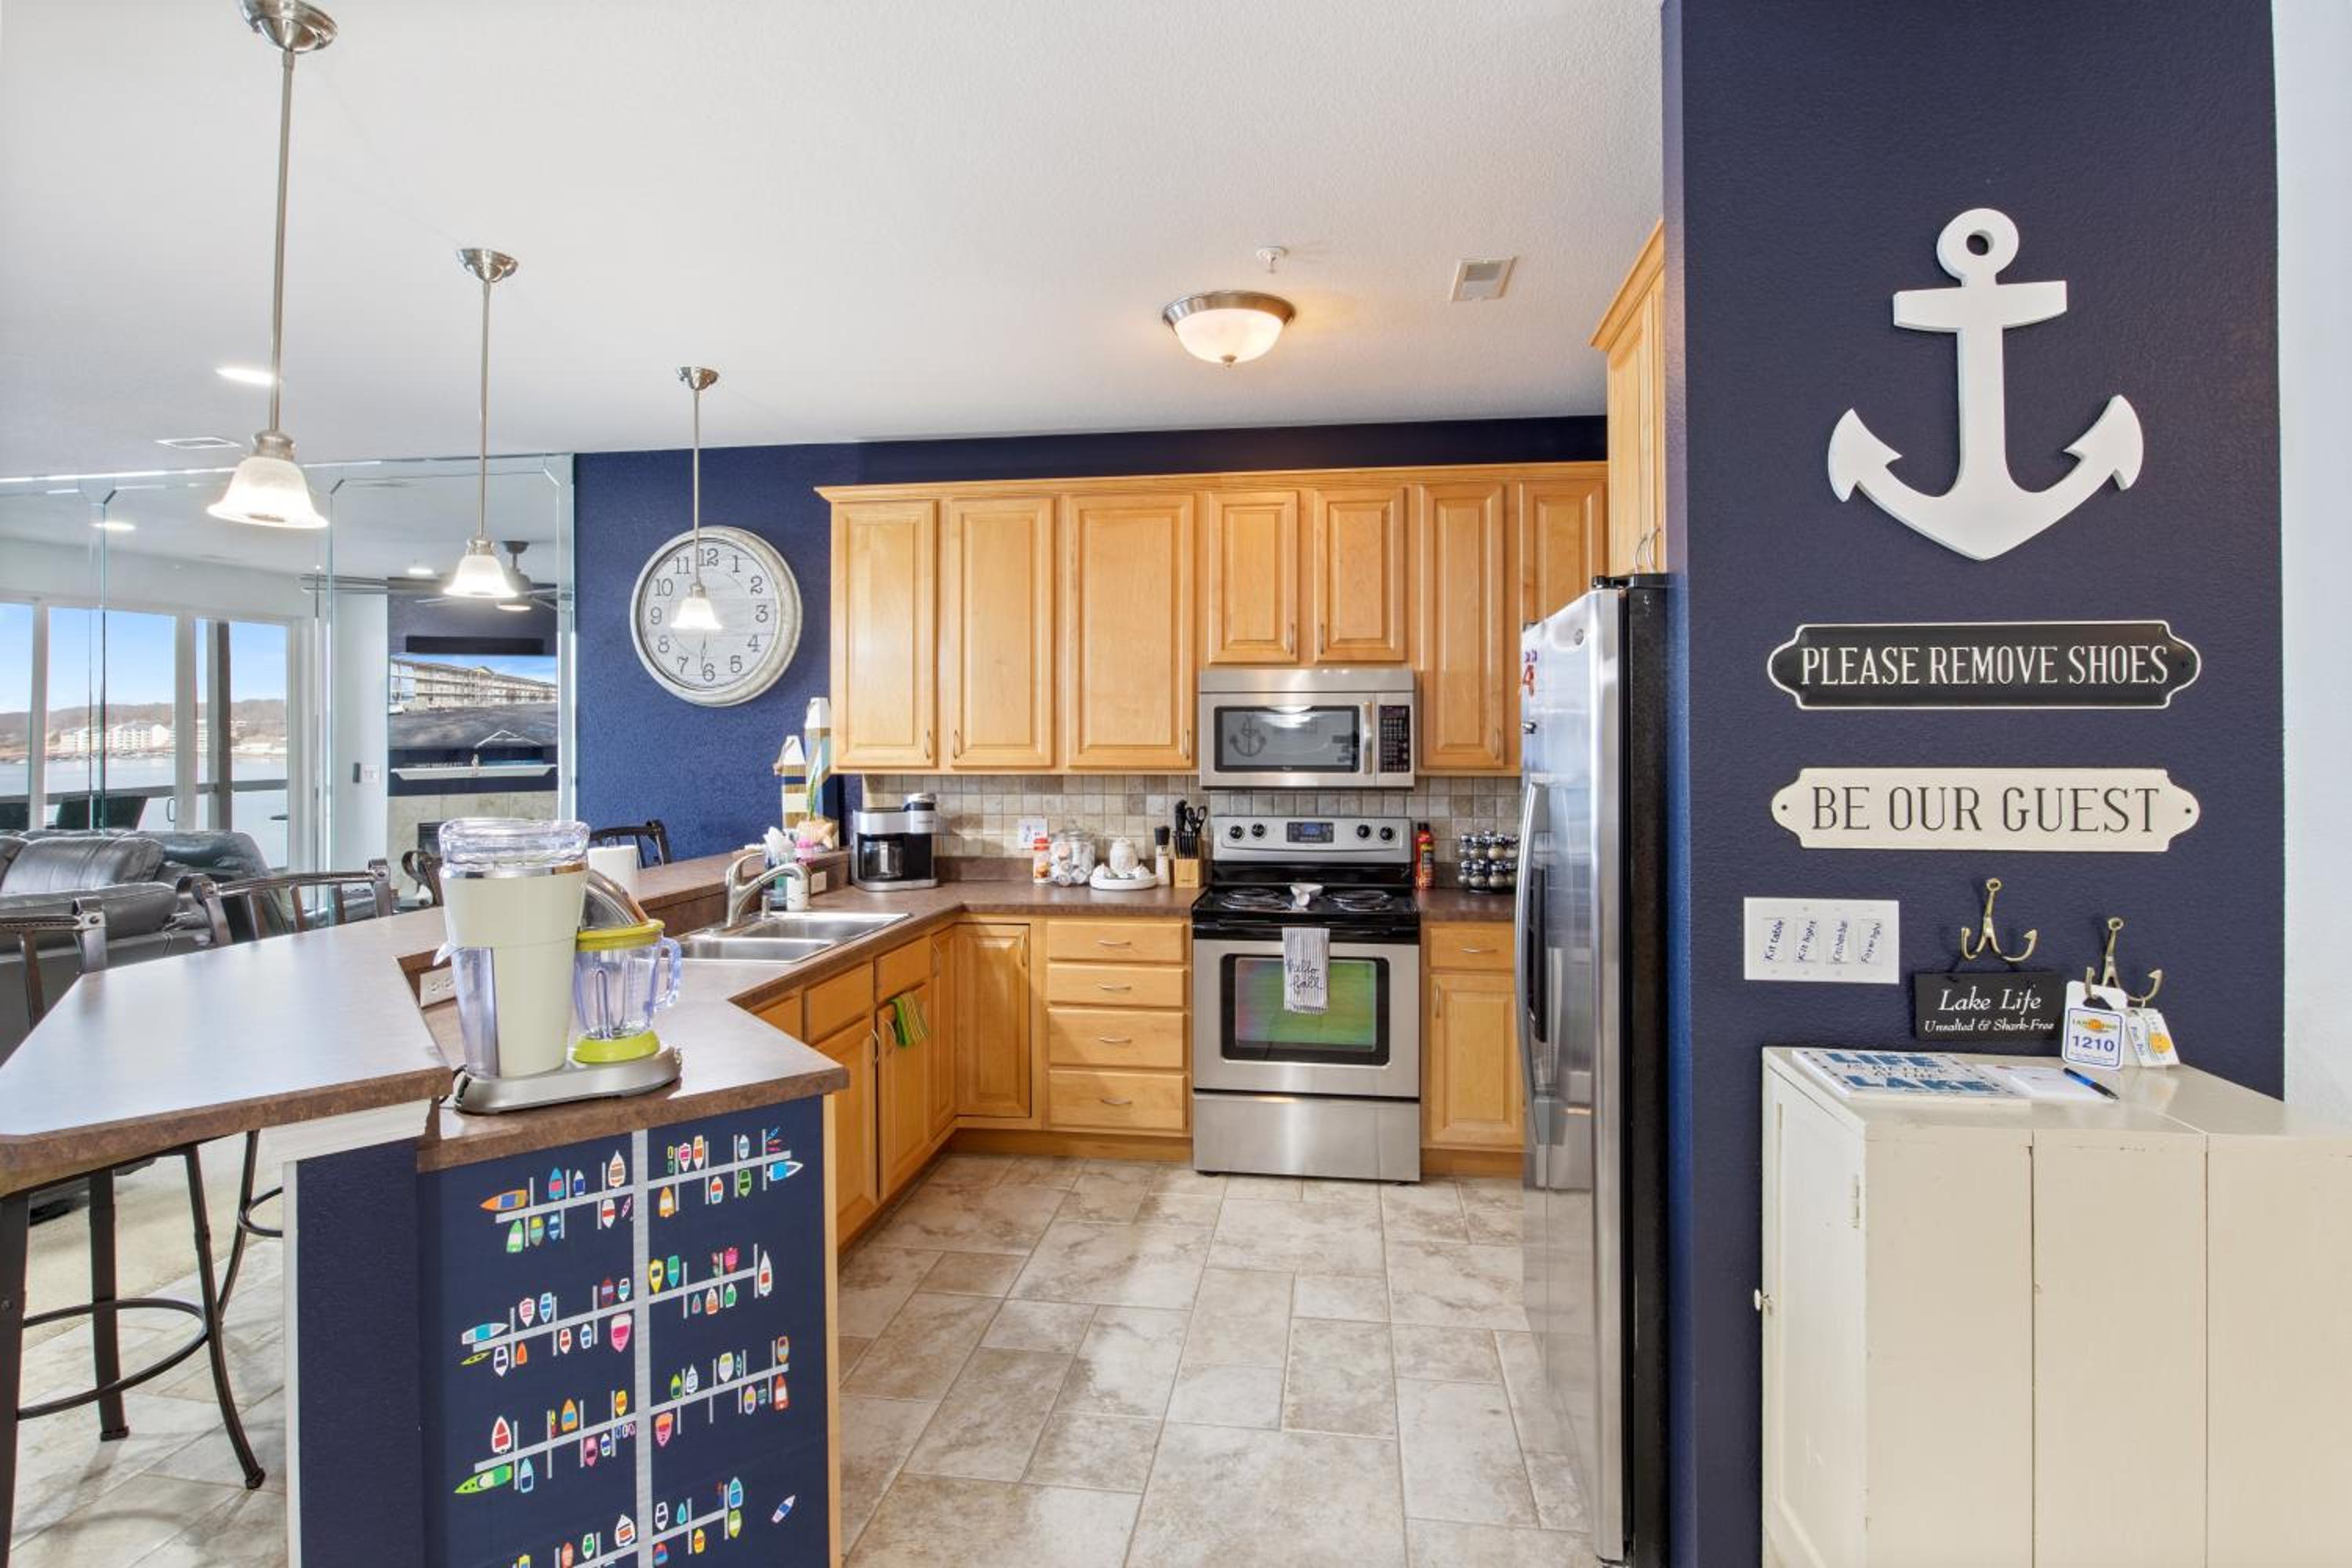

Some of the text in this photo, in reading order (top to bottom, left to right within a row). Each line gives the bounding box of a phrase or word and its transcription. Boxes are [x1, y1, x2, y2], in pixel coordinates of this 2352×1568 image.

[675, 557, 691, 575] 11
[698, 548, 719, 567] 12
[731, 555, 741, 573] 1
[655, 578, 673, 597] 10
[750, 575, 763, 594] 2
[650, 606, 662, 625] 9
[755, 604, 768, 623] 3
[658, 635, 670, 653] 8
[747, 634, 760, 652] 4
[677, 655, 689, 674] 7
[702, 662, 716, 682] 6
[730, 655, 742, 673] 5
[1801, 644, 2169, 685] PLEASE REMOVE SHOES
[1812, 786, 2160, 833] BE OUR GUEST
[1937, 985, 2042, 1015] Lake Life
[1924, 1017, 2055, 1033] Unsalted & Shark-Free
[2072, 1035, 2115, 1052] 1210
[1825, 1052, 1944, 1067] LIFE
[1844, 1075, 1999, 1091] LAKE
